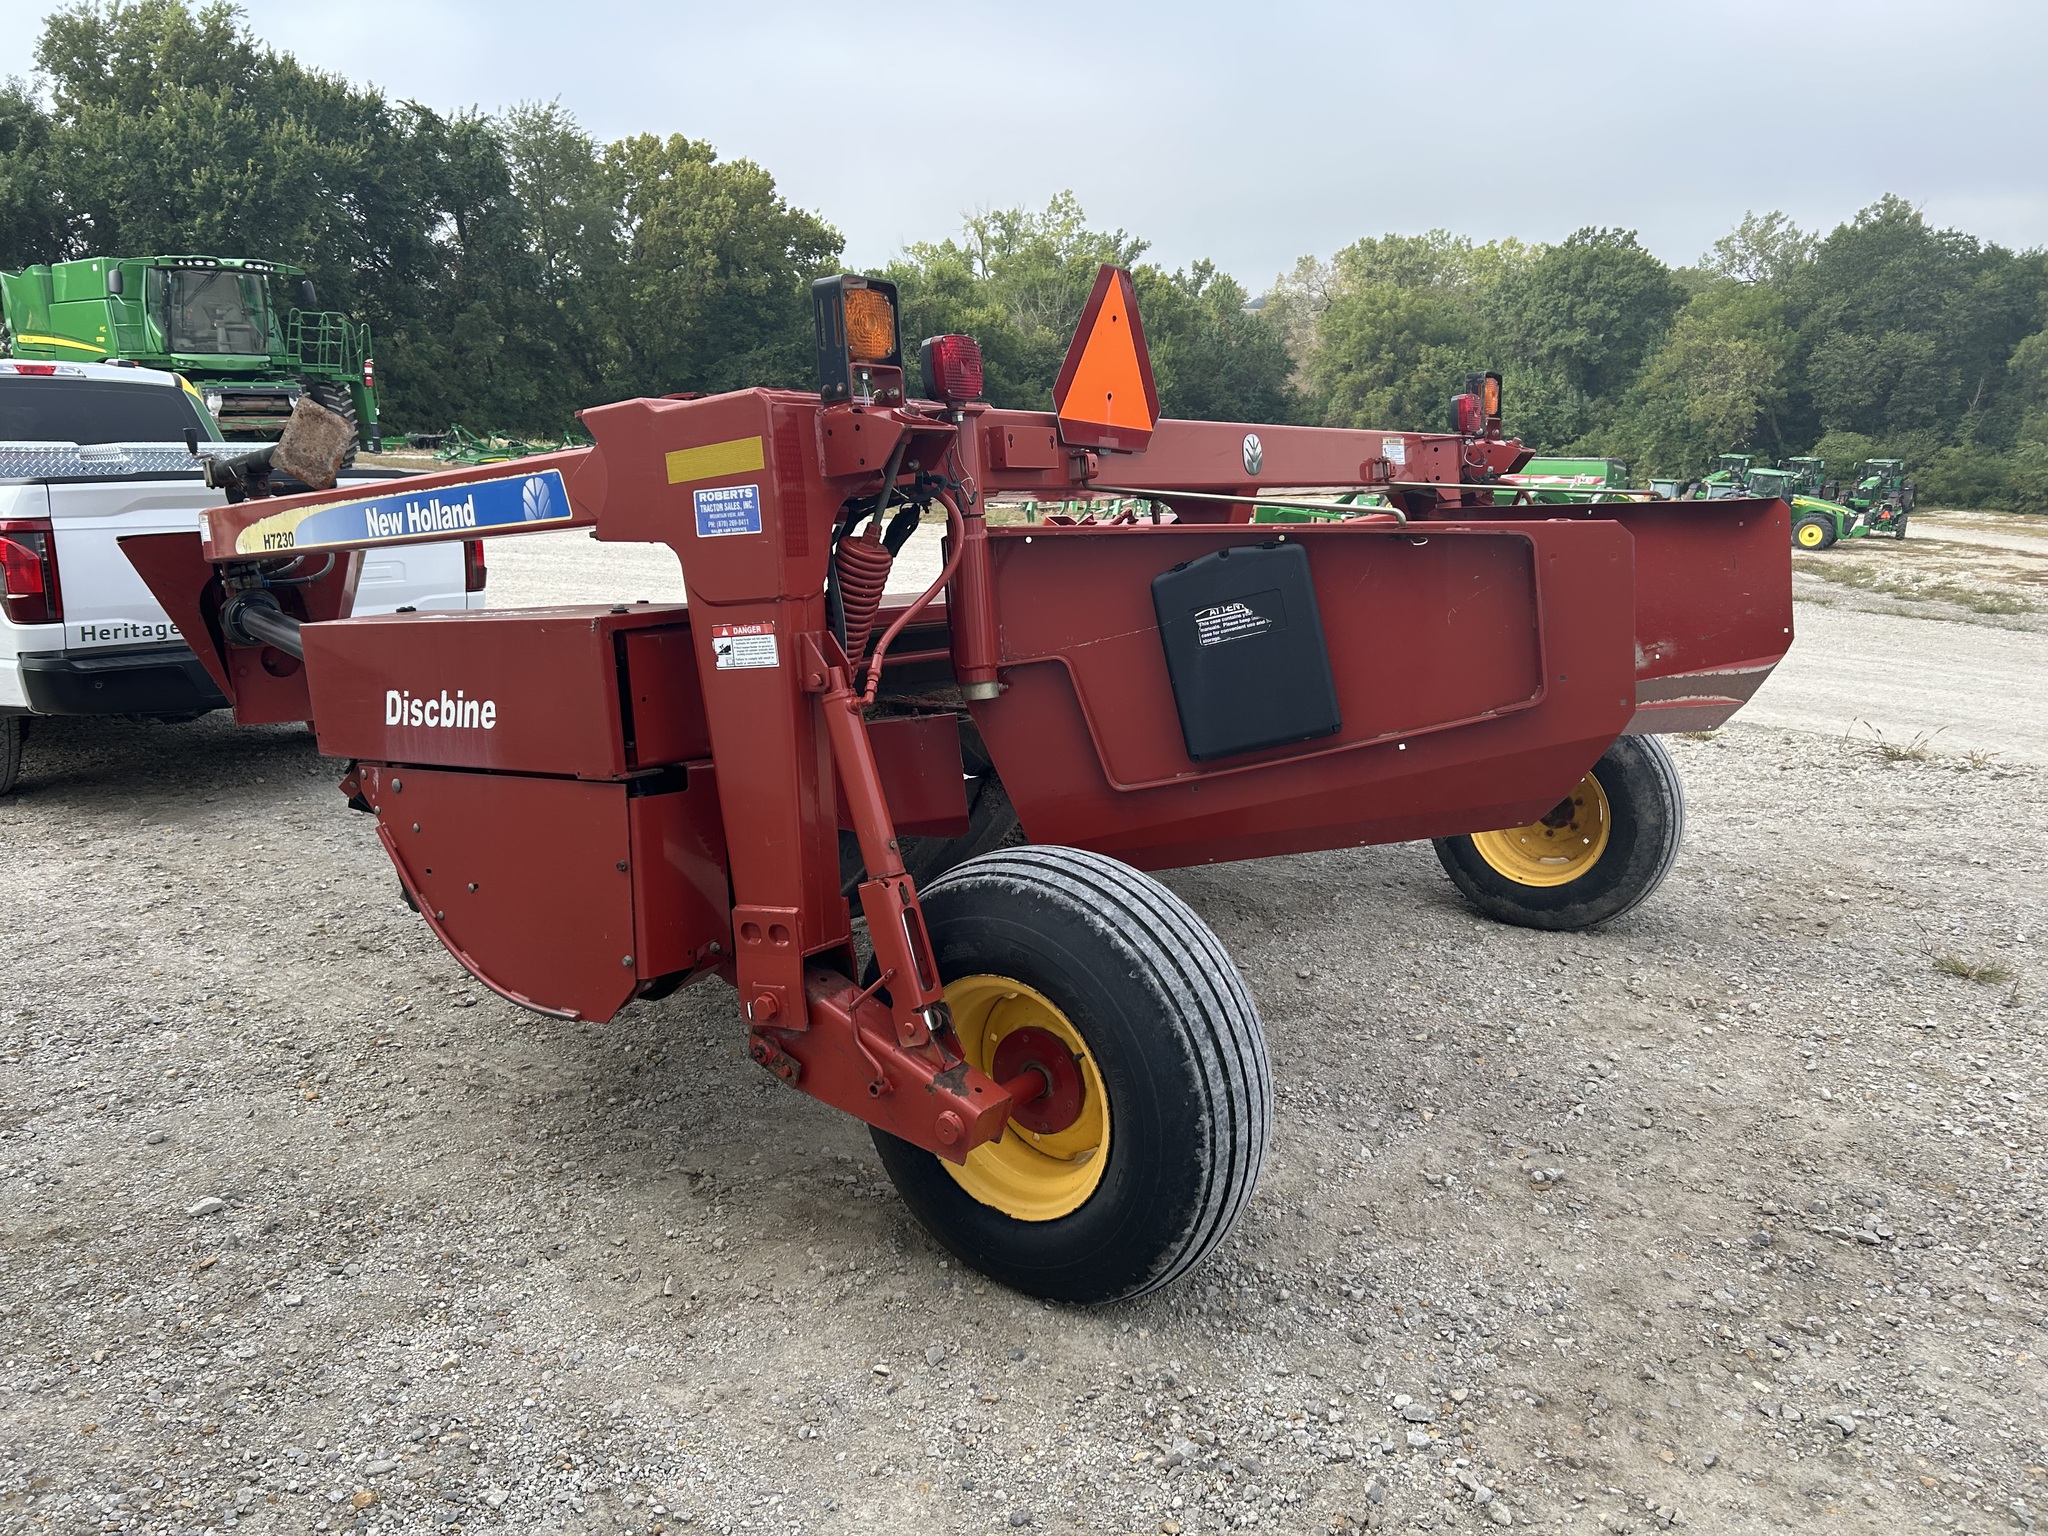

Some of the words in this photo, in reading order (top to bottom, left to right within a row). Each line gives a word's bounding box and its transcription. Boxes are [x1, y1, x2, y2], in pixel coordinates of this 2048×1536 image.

[698, 488, 753, 502] ROBERTS
[700, 503, 723, 513] TRACTOR
[724, 502, 742, 511] SALES,
[743, 500, 754, 510] INC.
[364, 507, 403, 537] New
[406, 494, 476, 532] Holland
[263, 531, 294, 550] H7230
[1221, 614, 1241, 622] contains
[80, 623, 181, 642] Heritage
[733, 626, 761, 635] DANGER
[1221, 624, 1246, 634] convenient
[385, 689, 497, 730] Discbine
